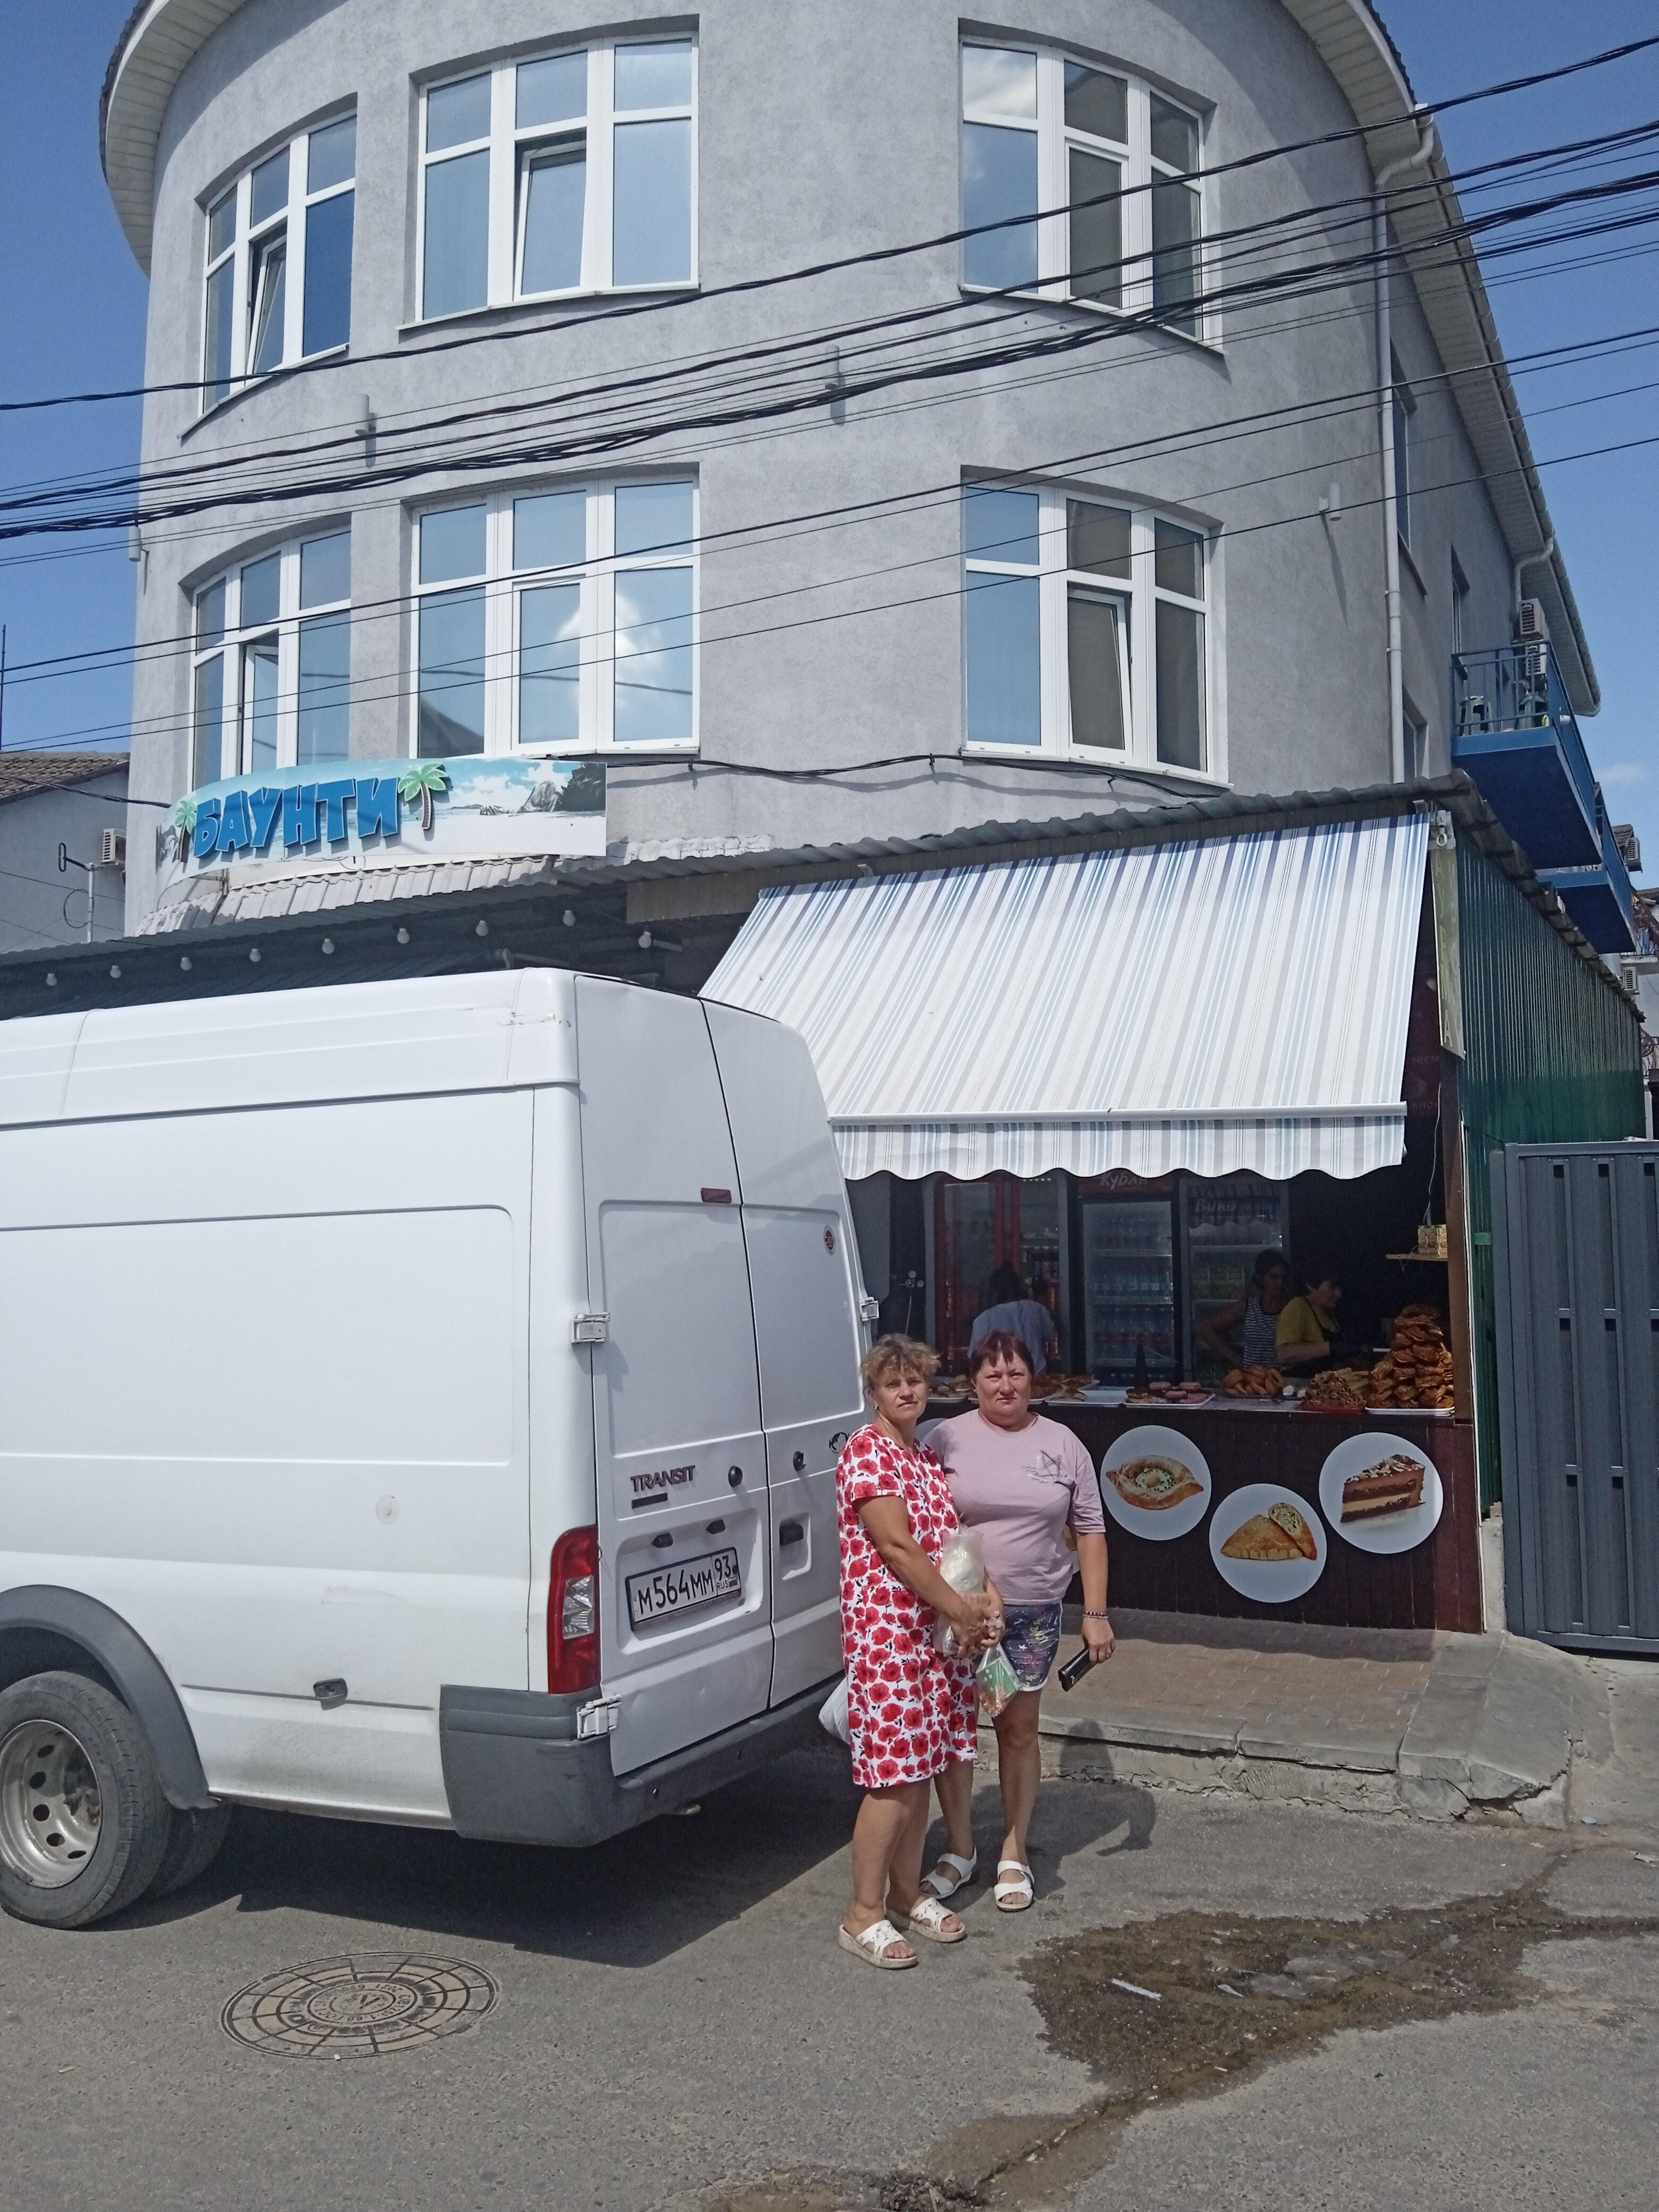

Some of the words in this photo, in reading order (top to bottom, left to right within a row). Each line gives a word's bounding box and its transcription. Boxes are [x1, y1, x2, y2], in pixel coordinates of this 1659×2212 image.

[194, 777, 399, 858] БАУНТИ
[631, 1465, 696, 1492] TRANSIT
[638, 1569, 714, 1614] М564ММ
[714, 1555, 731, 1581] 93
[717, 1580, 728, 1590] RUS
